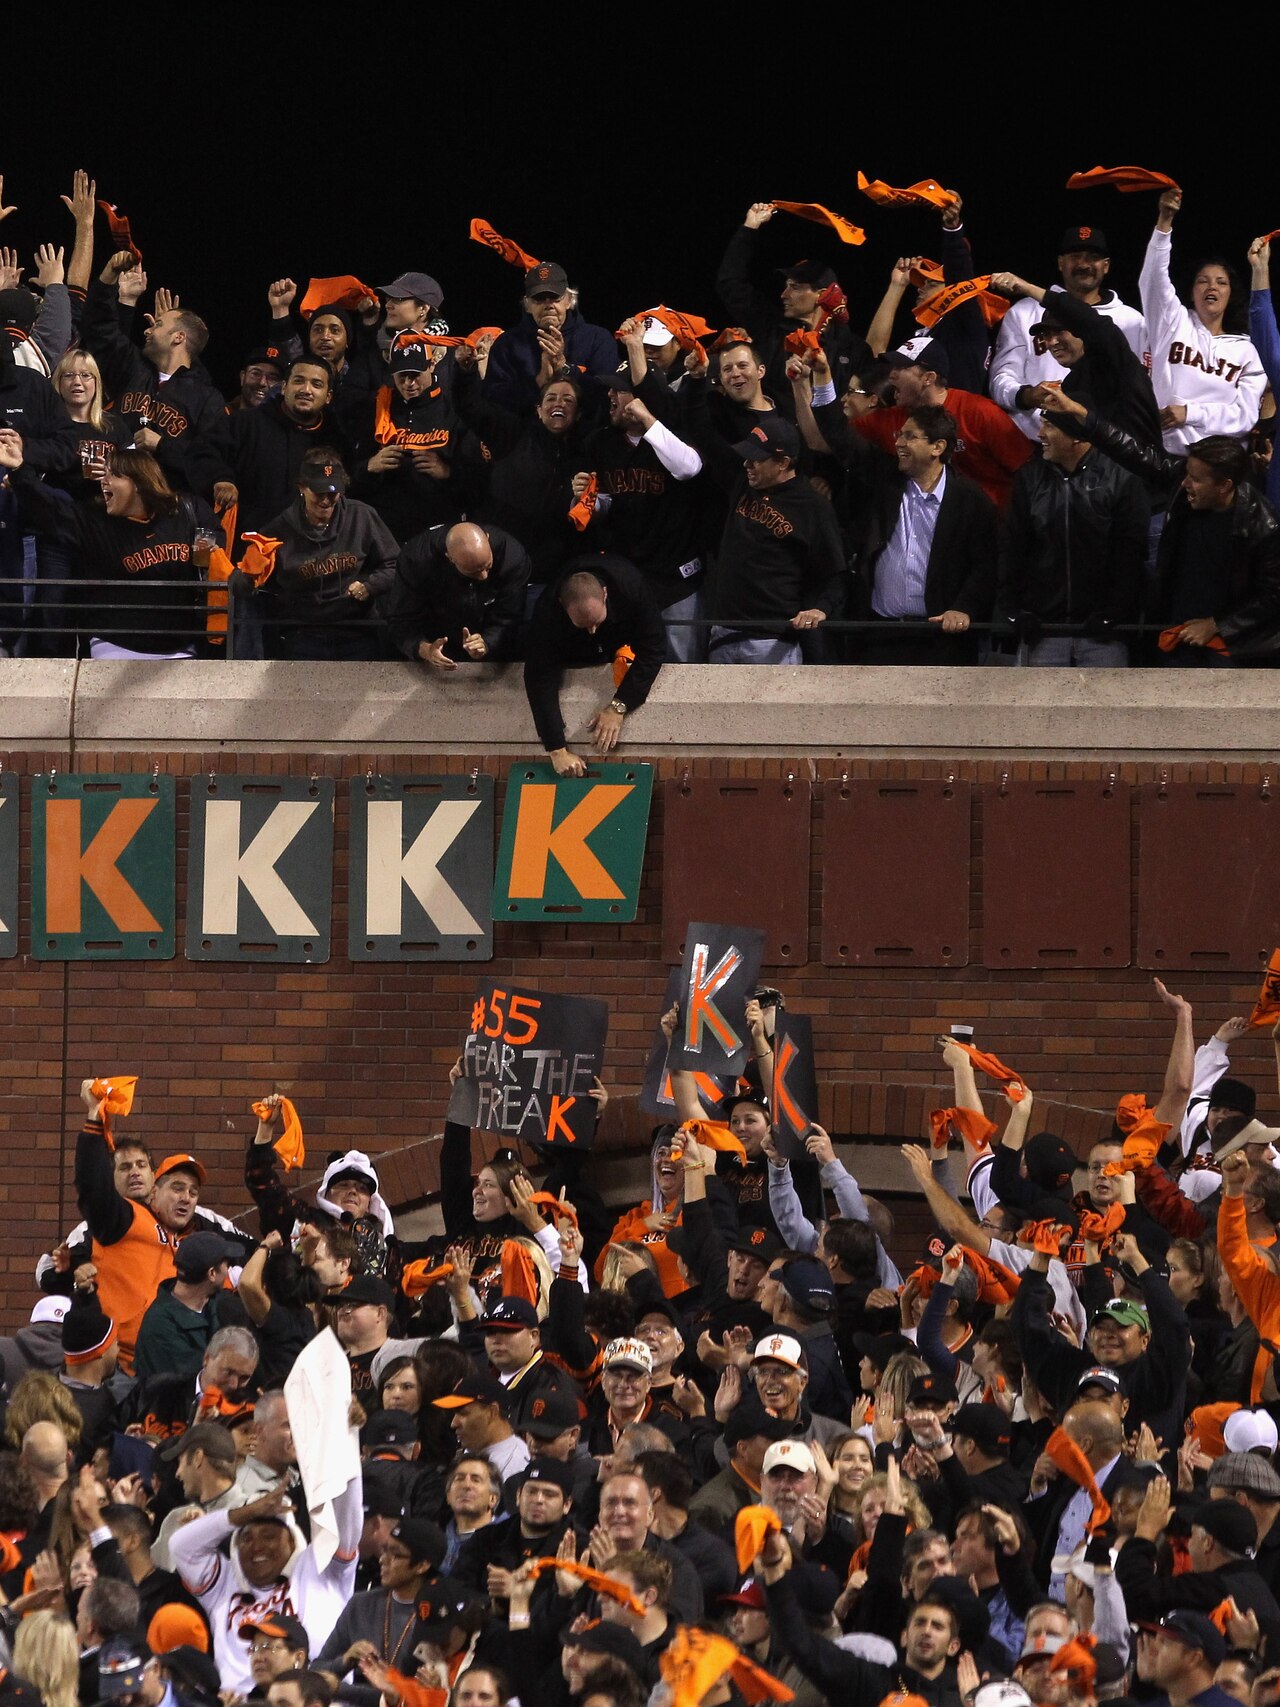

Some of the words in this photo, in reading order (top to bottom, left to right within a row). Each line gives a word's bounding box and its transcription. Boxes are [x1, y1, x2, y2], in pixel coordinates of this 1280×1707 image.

[120, 392, 188, 437] GIANTS
[122, 543, 190, 573] GIANTS
[46, 798, 162, 933] K
[203, 799, 320, 936] K
[367, 800, 483, 935] K
[508, 784, 635, 899] K
[471, 988, 542, 1046] #55
[683, 943, 745, 1058] K
[463, 1033, 519, 1083] FEAR
[522, 1049, 596, 1097] THE
[475, 1082, 576, 1143] FREAK
